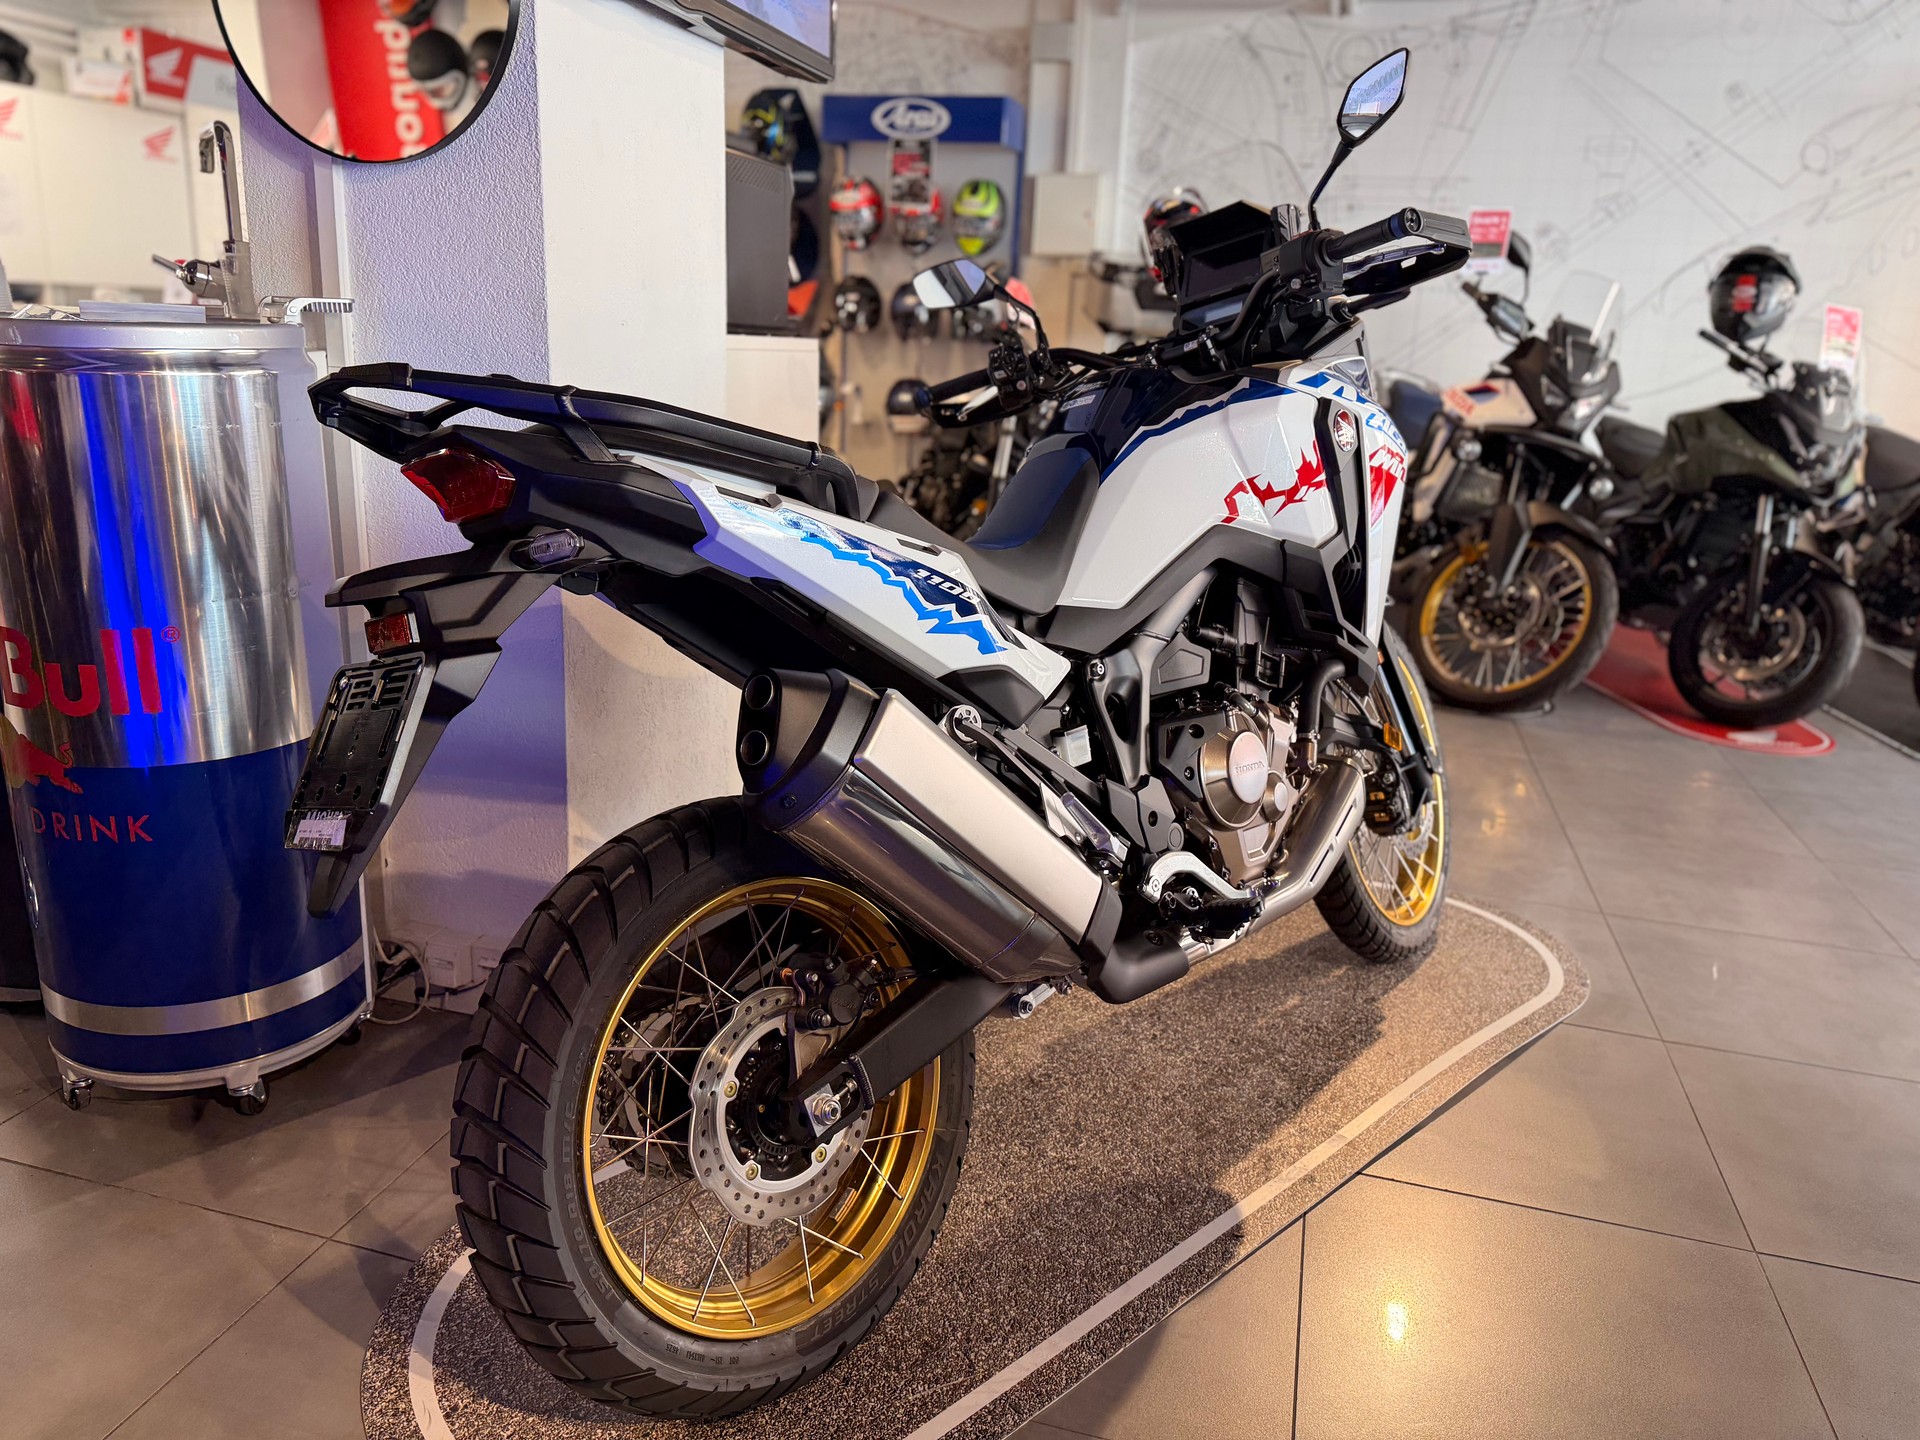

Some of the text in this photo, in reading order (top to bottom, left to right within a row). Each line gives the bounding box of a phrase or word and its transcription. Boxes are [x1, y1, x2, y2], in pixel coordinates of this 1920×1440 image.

[1234, 760, 1265, 776] HONDA
[29, 806, 153, 843] DRINK
[810, 1157, 946, 1342] KAROO STREET
